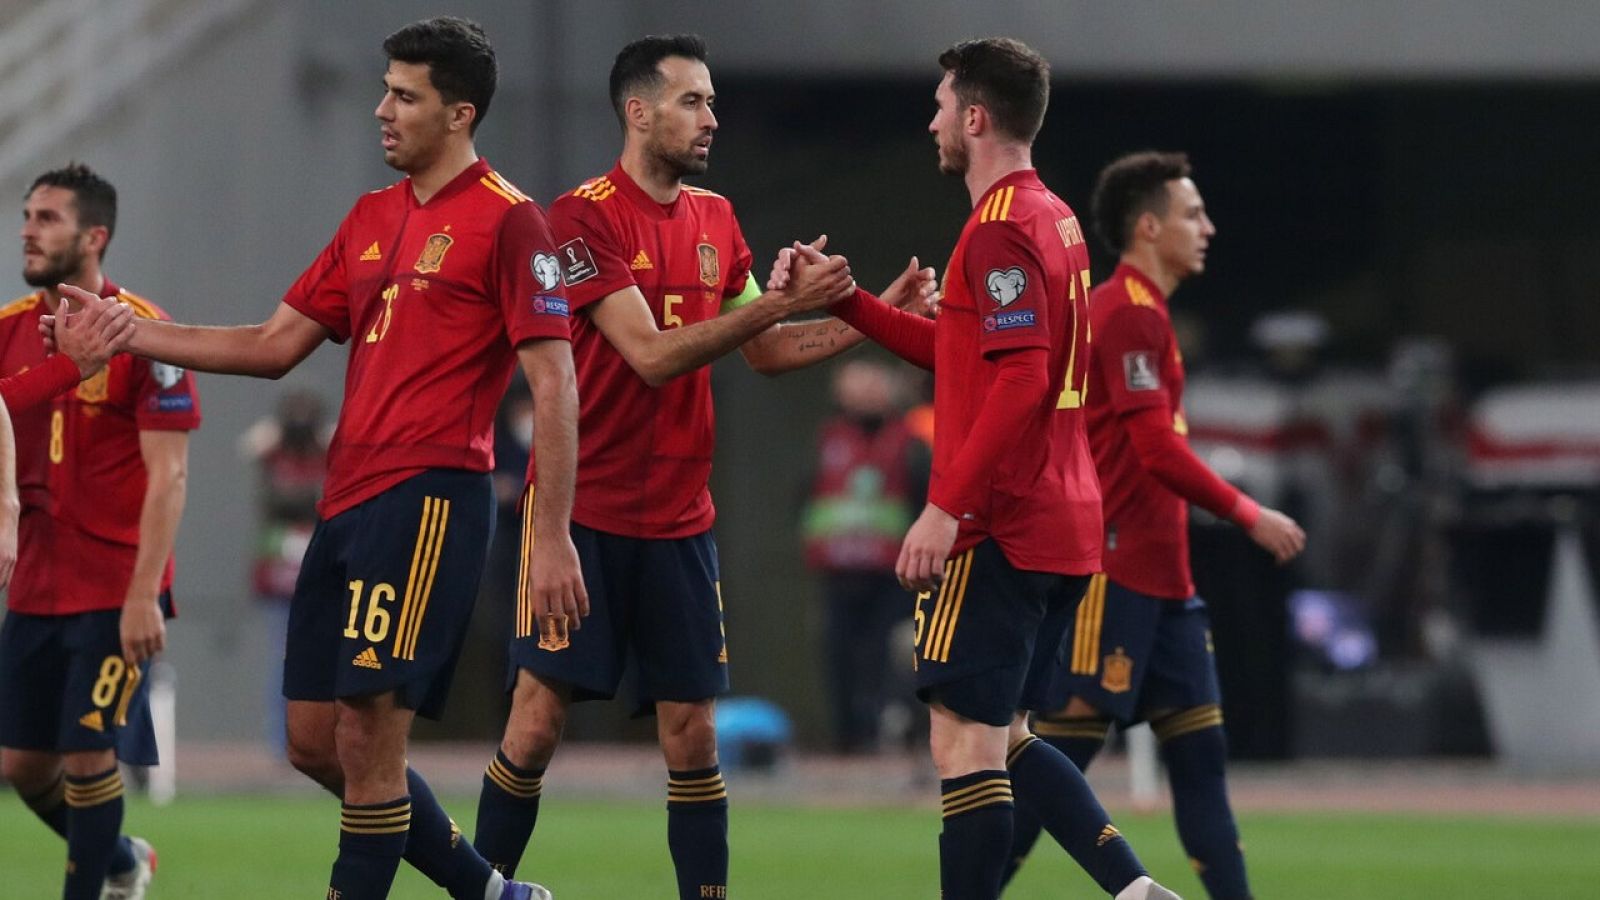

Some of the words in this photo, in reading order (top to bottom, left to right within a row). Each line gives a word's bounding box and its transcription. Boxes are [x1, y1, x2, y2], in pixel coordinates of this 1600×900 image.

[664, 294, 684, 329] 5
[997, 314, 1034, 326] RESPECT
[50, 410, 64, 464] 8
[344, 580, 396, 642] 16
[92, 655, 125, 708] 8
[352, 659, 383, 670] adidas
